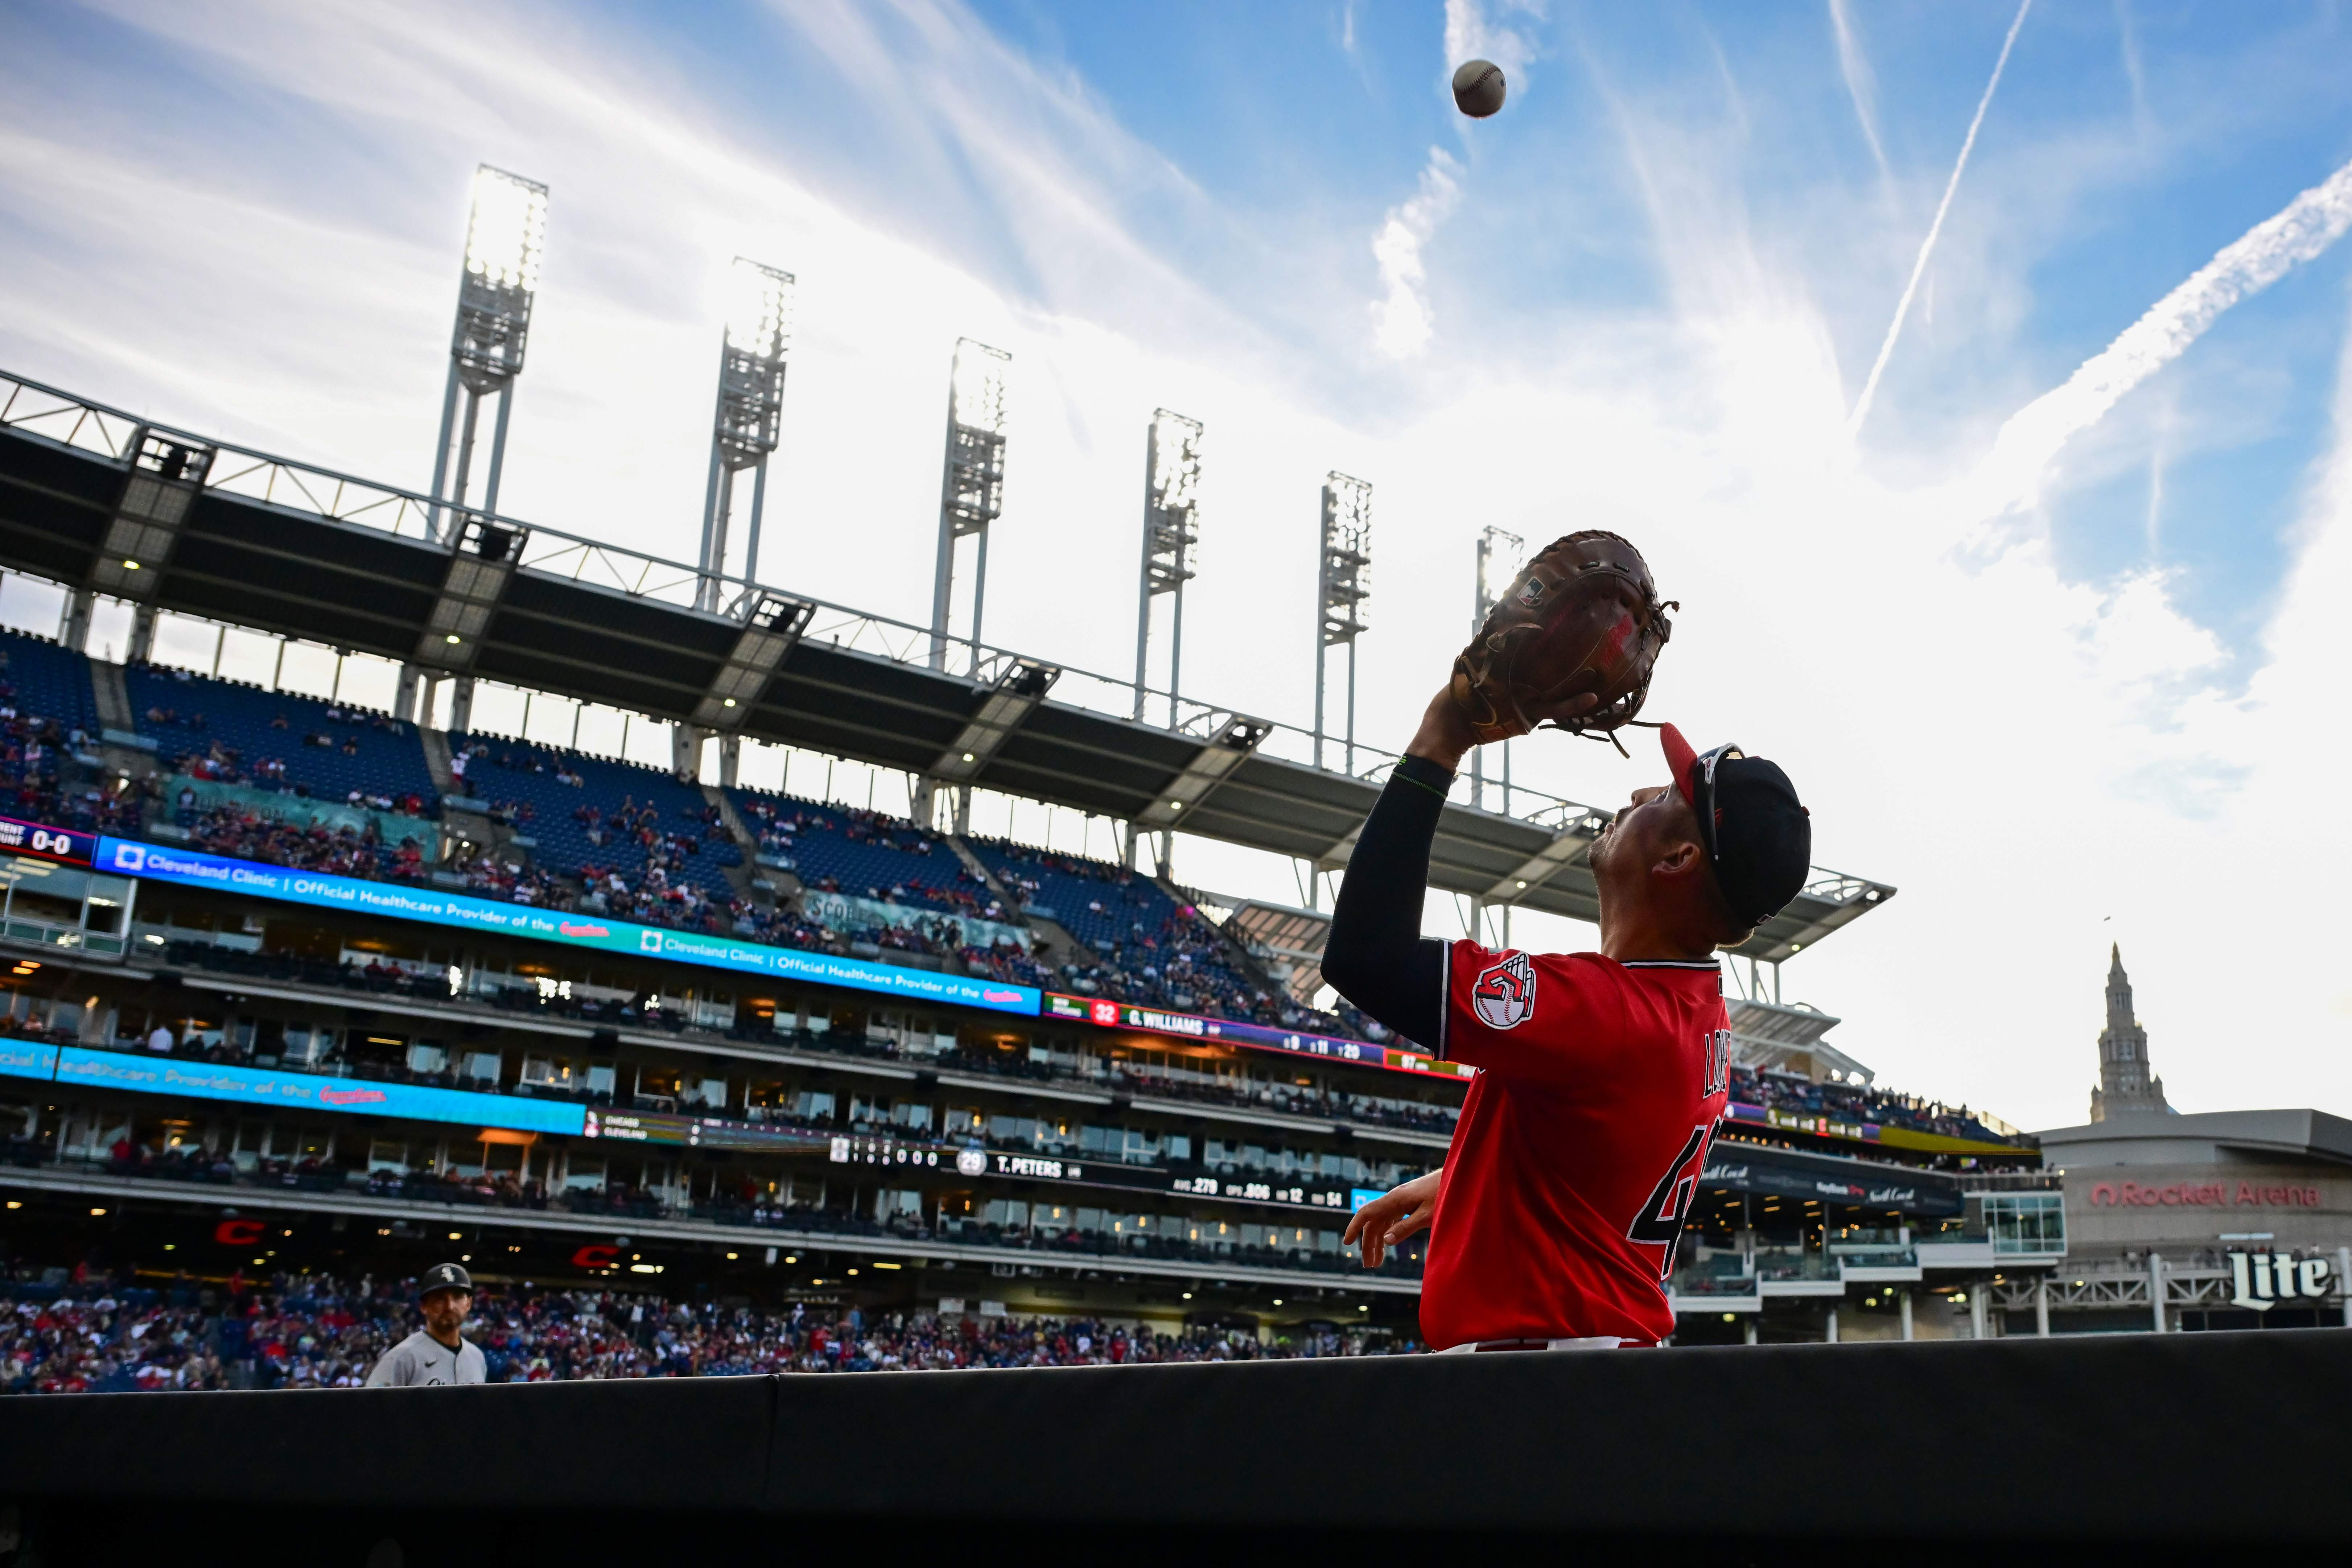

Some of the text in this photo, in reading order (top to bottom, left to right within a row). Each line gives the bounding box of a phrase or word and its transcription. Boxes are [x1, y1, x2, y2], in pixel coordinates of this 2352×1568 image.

[32, 830, 71, 855] 0-0
[147, 854, 230, 880] Cleveland
[232, 868, 277, 887] Clinic
[294, 879, 355, 900] Official
[360, 890, 442, 914] Healthcare
[446, 903, 507, 924] Provider
[512, 915, 528, 927] of
[532, 918, 554, 932] the
[665, 938, 727, 959] Cleveland
[730, 949, 763, 965] Clinic
[778, 957, 824, 973] Official
[828, 964, 891, 985] Healthcare
[895, 974, 943, 992] Provider
[946, 984, 958, 994] of
[961, 986, 979, 998] the
[1095, 1003, 1115, 1023] 32
[1317, 1039, 1329, 1055] 11
[165, 1069, 247, 1090] Provider
[254, 1081, 276, 1094] of
[282, 1084, 312, 1098] the
[897, 1149, 938, 1166] 0 0 0
[1289, 1187, 1303, 1203] 12
[2122, 1181, 2321, 1206] Rocket Arena
[2227, 1252, 2330, 1312] Lite
